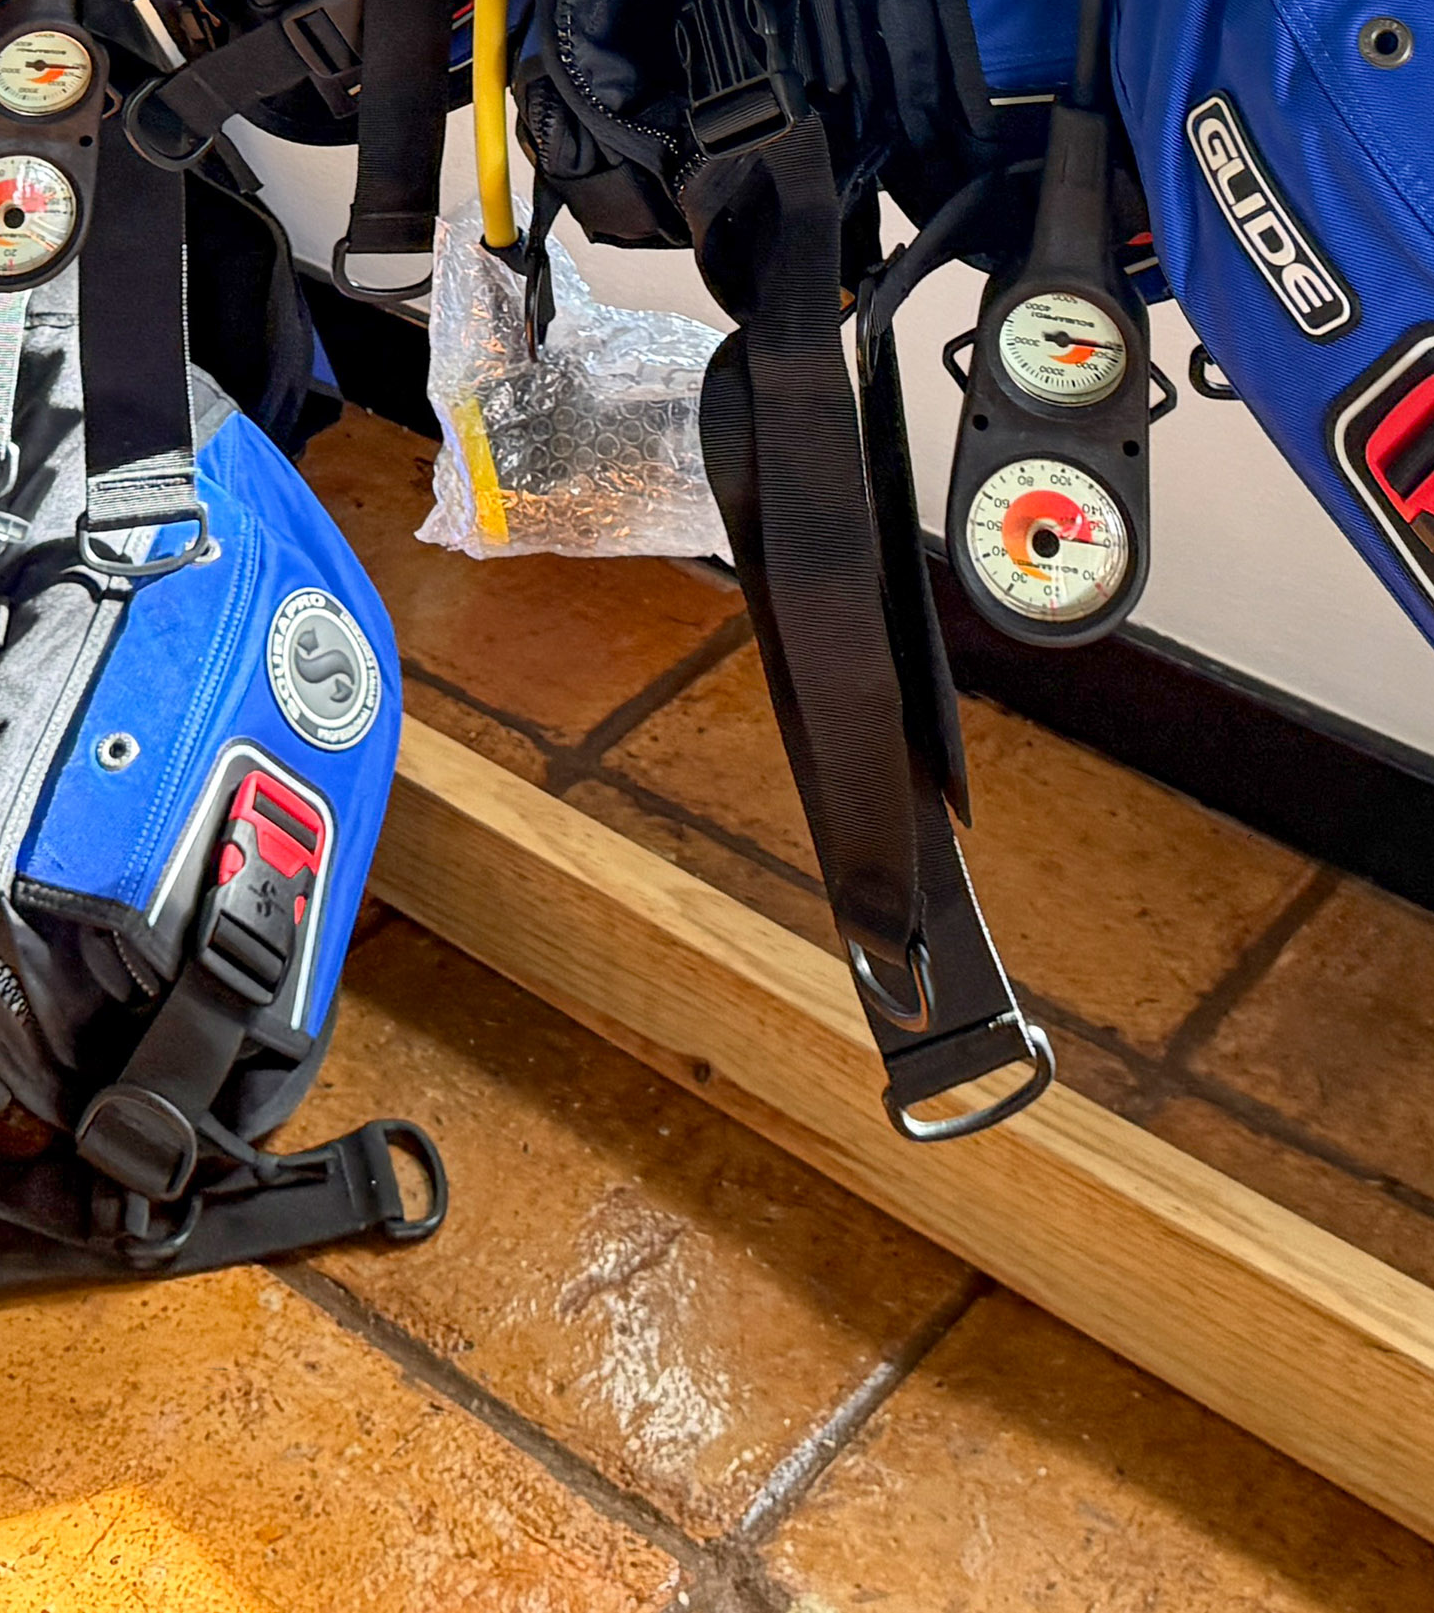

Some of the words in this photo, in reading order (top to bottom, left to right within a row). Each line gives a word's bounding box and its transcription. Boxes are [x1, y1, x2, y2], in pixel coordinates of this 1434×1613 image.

[1198, 118, 1334, 314] GLIDE
[1017, 475, 1035, 487] 80
[1049, 474, 1073, 487] 100
[993, 497, 1011, 510] 60
[986, 519, 1003, 532] 50
[991, 545, 1008, 558] 40
[1010, 571, 1029, 584] 30
